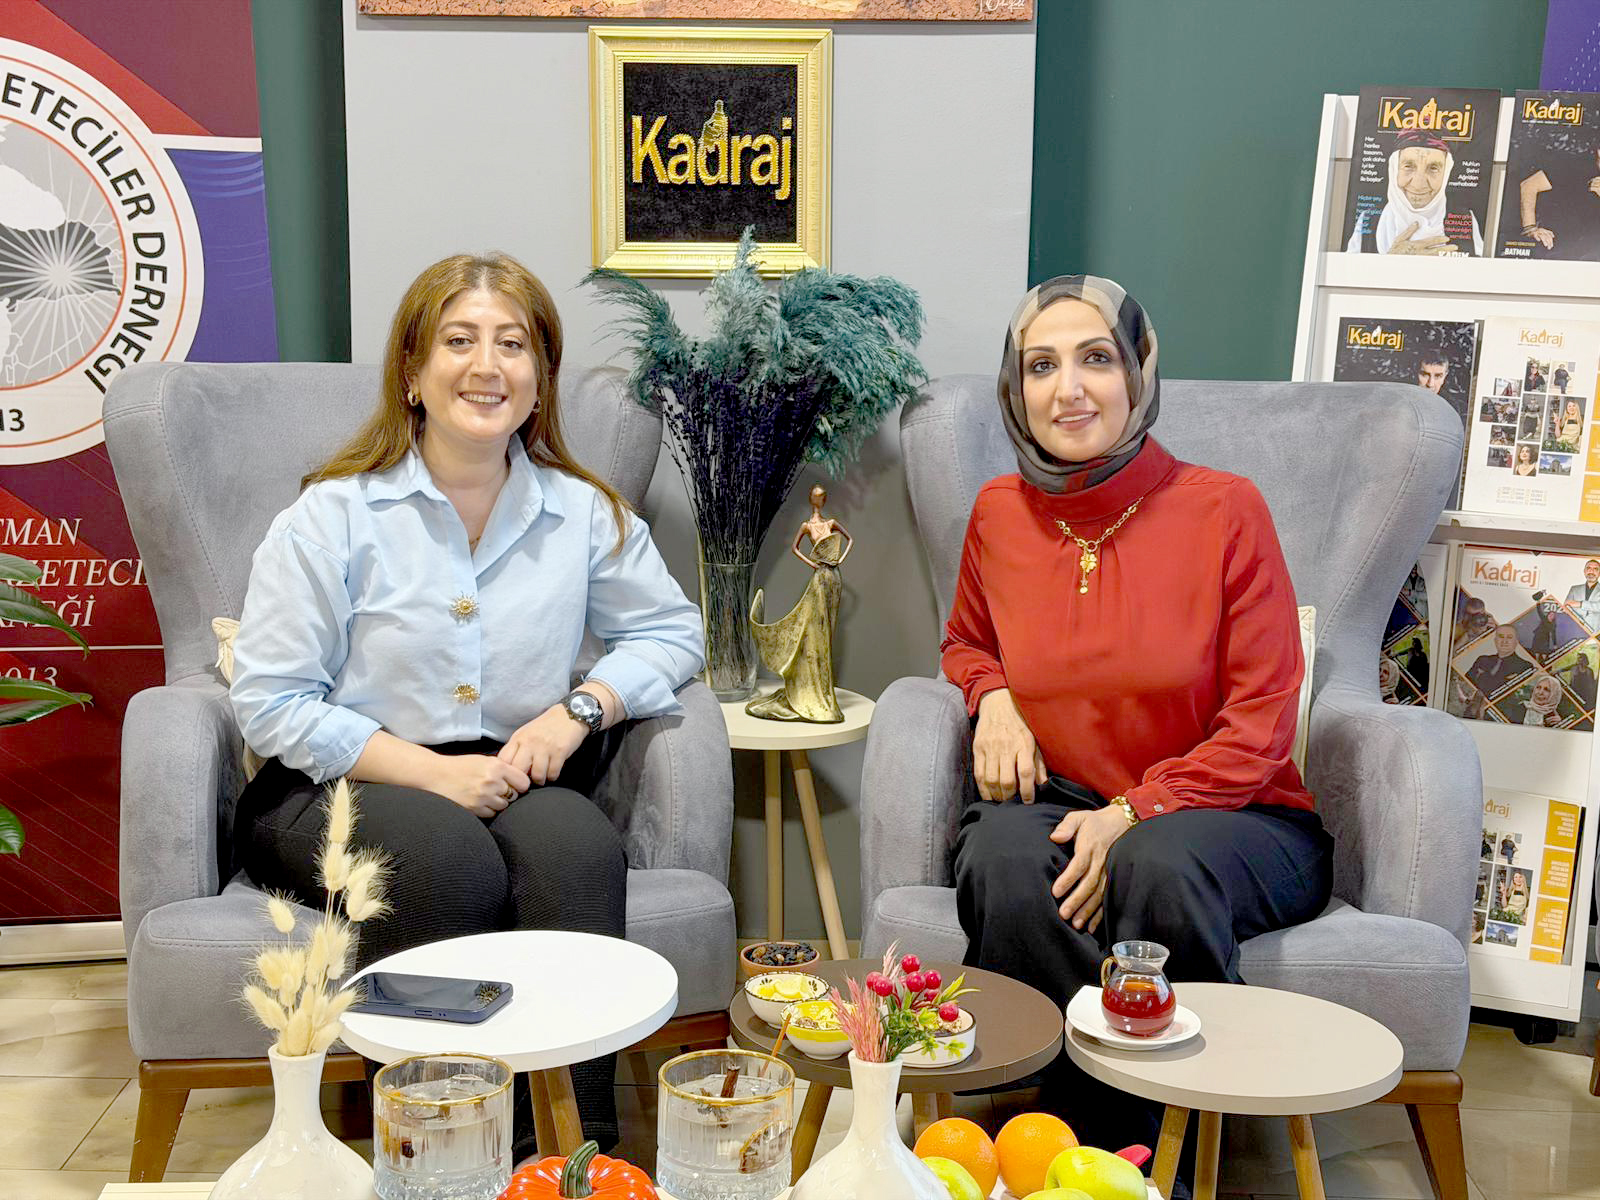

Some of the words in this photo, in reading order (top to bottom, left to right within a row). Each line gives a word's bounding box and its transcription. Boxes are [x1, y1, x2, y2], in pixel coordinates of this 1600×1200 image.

[1382, 97, 1471, 137] Kadraj
[1525, 98, 1581, 124] Kadraj
[631, 99, 793, 201] Kadraj
[1504, 247, 1531, 257] BATMAN
[1349, 325, 1402, 350] Kadraj
[1520, 329, 1564, 348] Kadraj
[1474, 559, 1538, 588] Kadraj
[1485, 799, 1511, 818] draj
